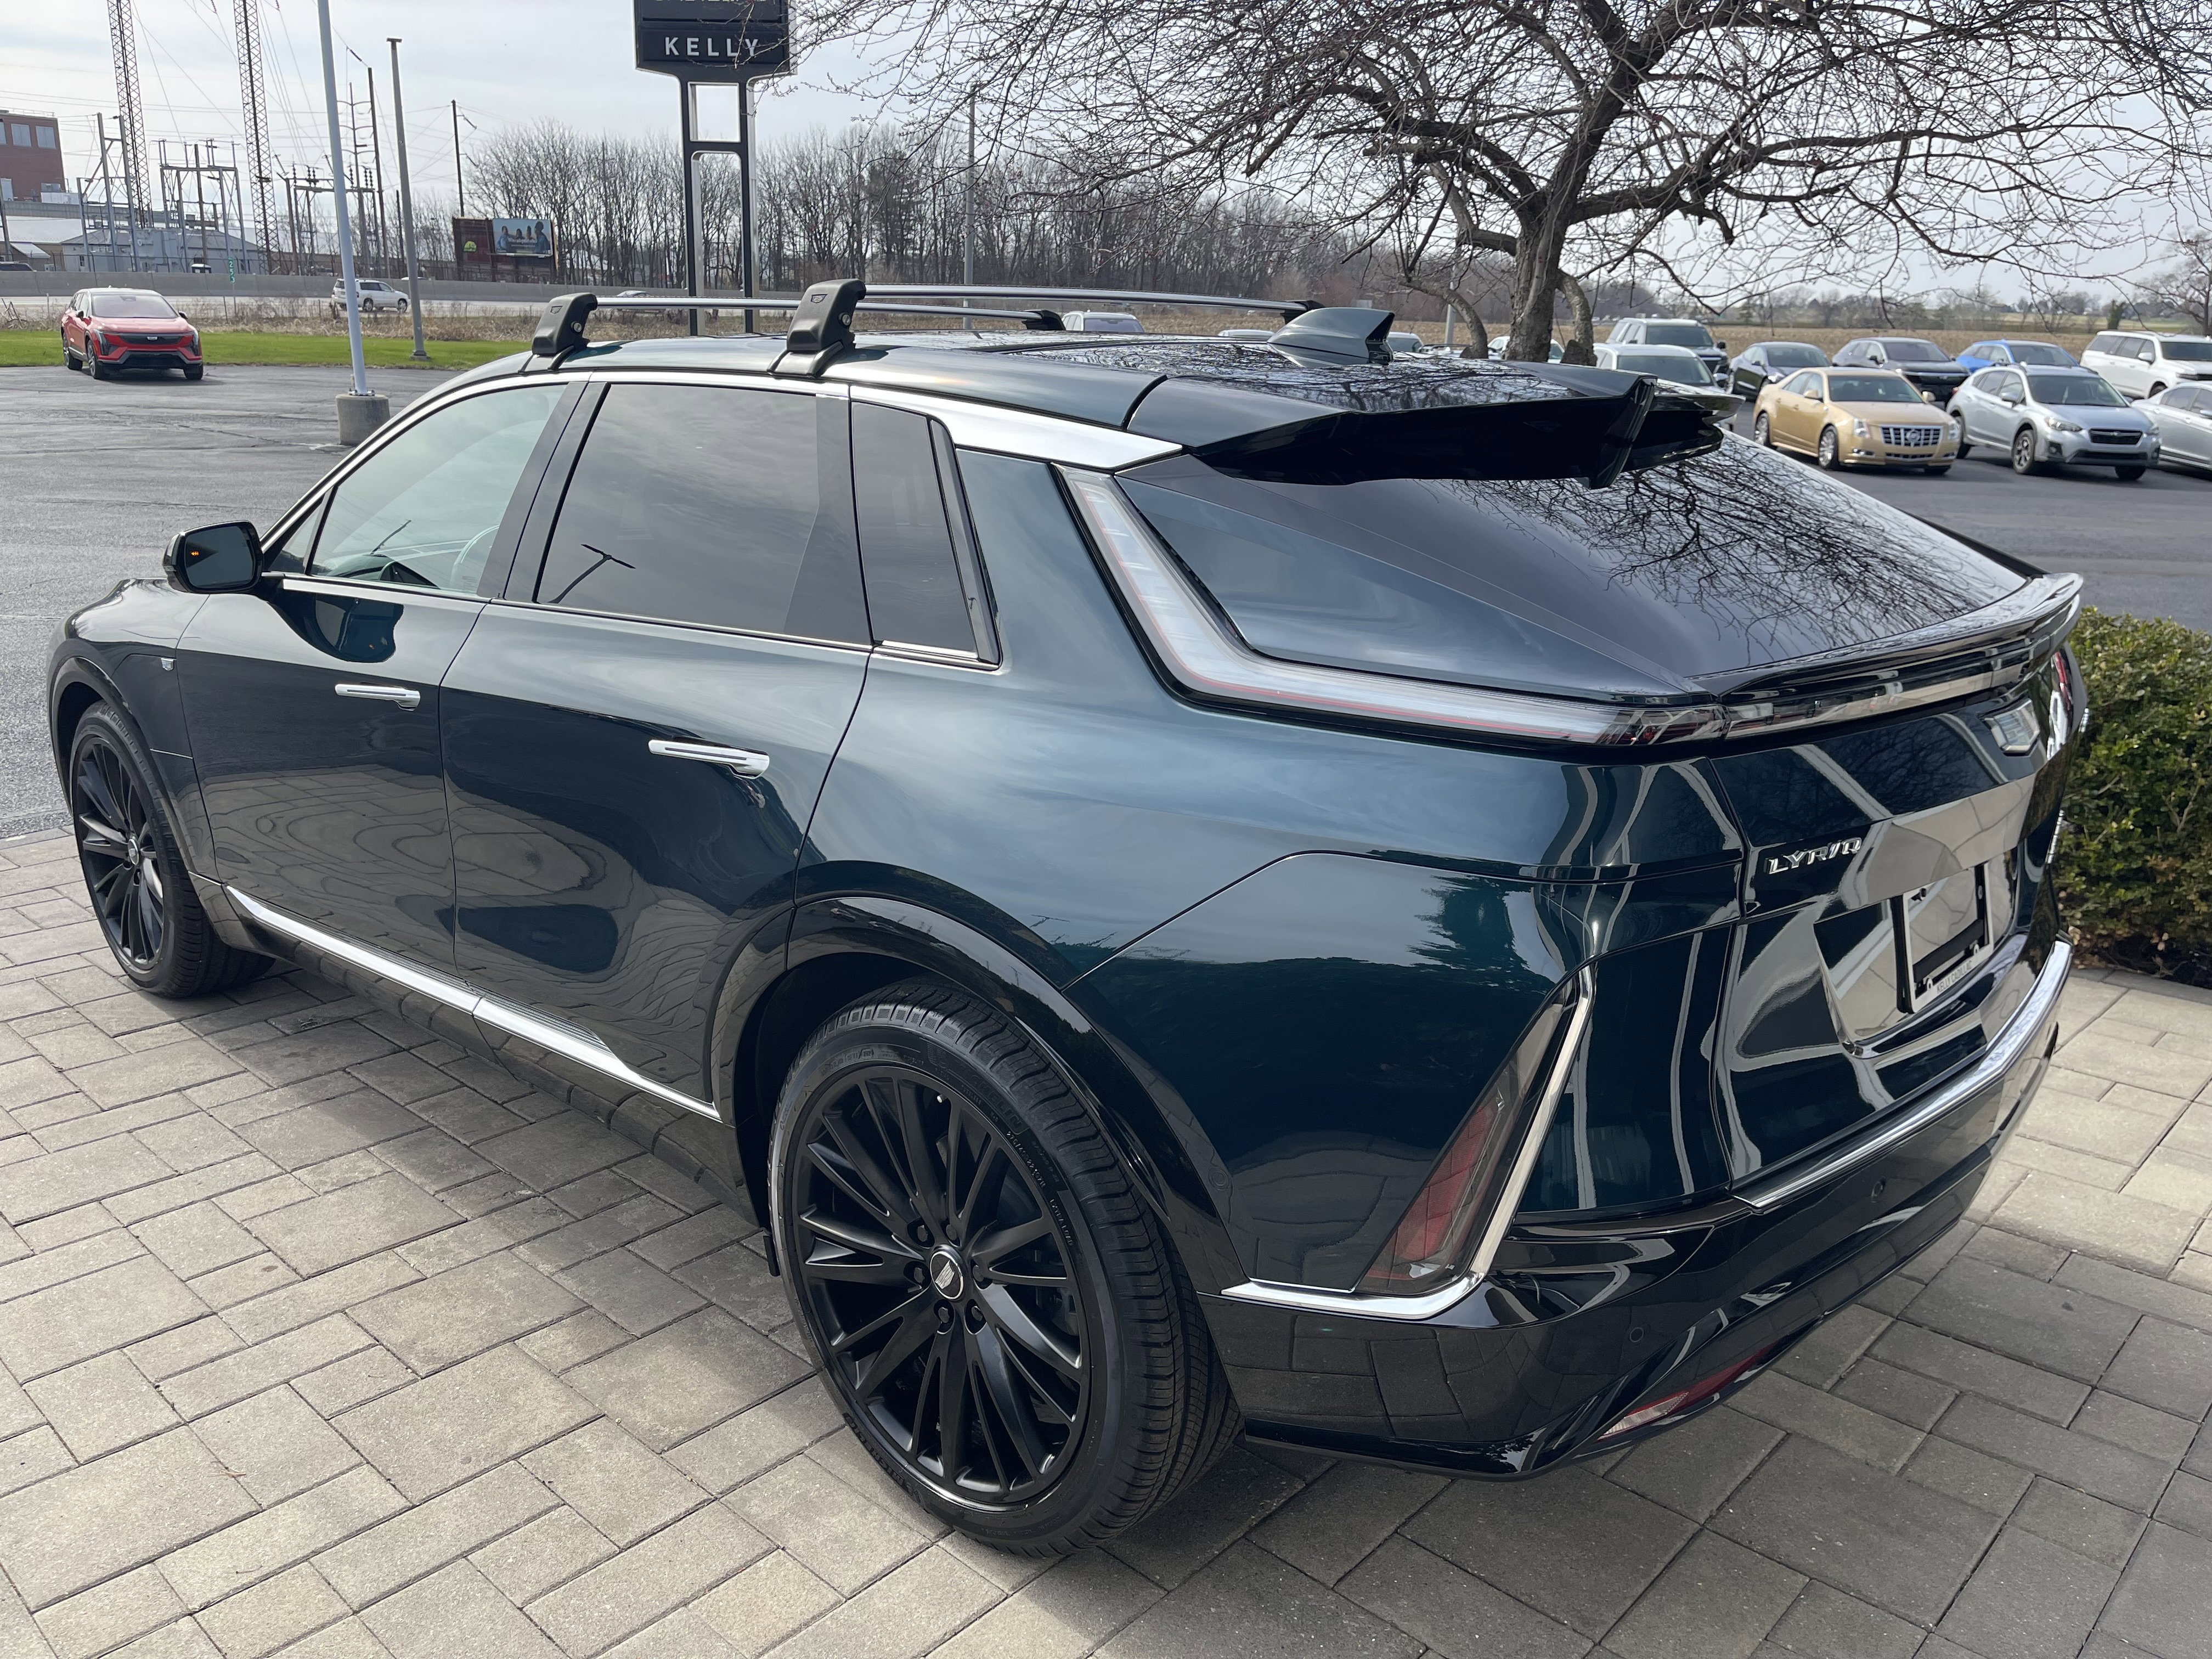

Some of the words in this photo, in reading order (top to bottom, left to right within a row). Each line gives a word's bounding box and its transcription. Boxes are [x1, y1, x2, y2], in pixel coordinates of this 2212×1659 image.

[665, 37, 759, 57] KELLY
[1765, 837, 1862, 874] LYRIQ
[1937, 978, 1950, 994] KELLY
[1951, 961, 1972, 983] CADILLAC
[844, 1415, 905, 1486] MICHELIN
